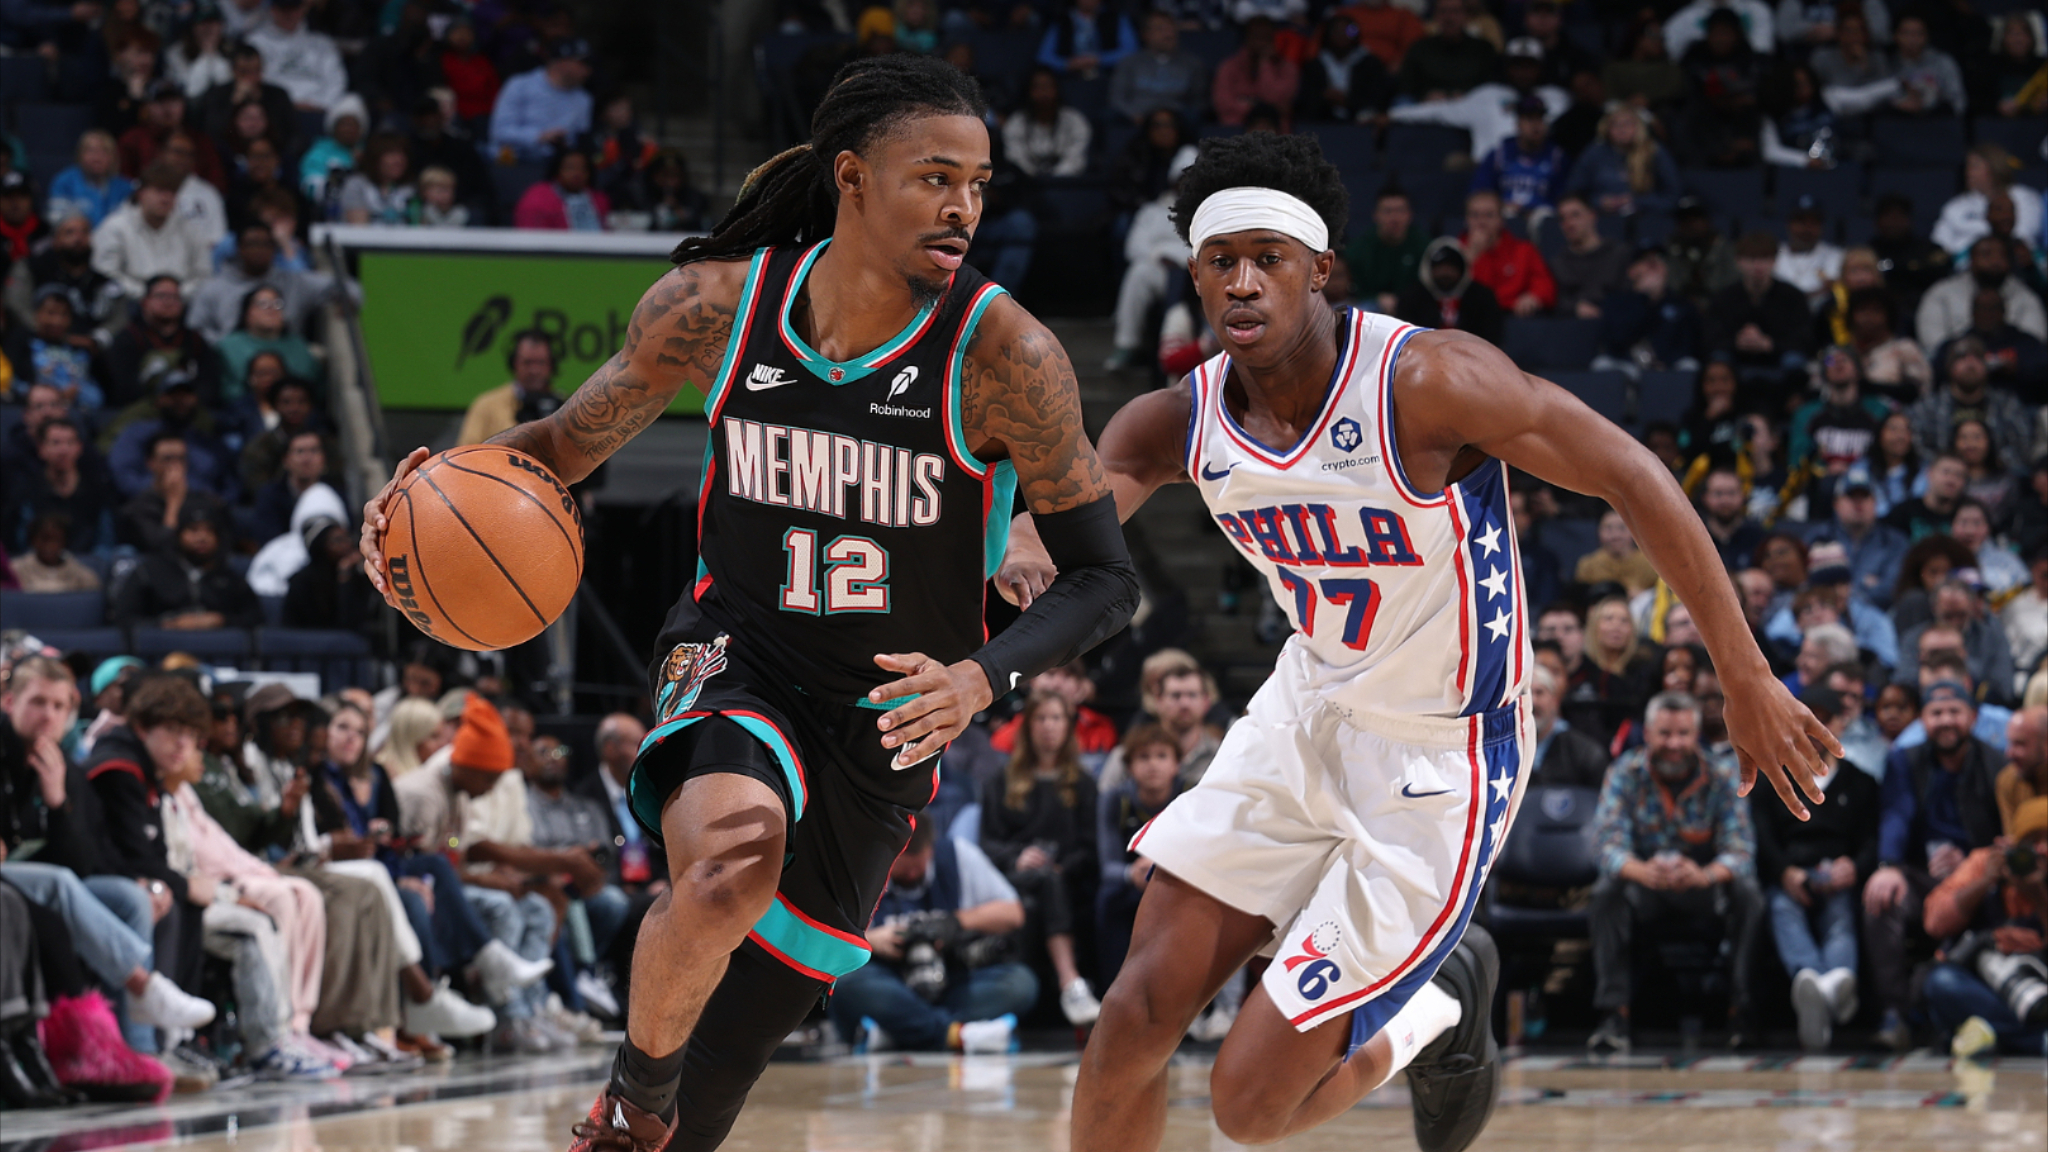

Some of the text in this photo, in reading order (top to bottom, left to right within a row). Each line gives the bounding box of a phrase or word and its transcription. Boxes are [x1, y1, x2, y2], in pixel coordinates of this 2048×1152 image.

[752, 363, 785, 384] NIKE
[869, 402, 931, 419] Robinhood
[723, 415, 946, 528] MEMPHIS
[1321, 455, 1381, 472] crypto.com
[1215, 503, 1425, 567] PHILA
[778, 525, 892, 617] 12
[1275, 564, 1382, 652] 77
